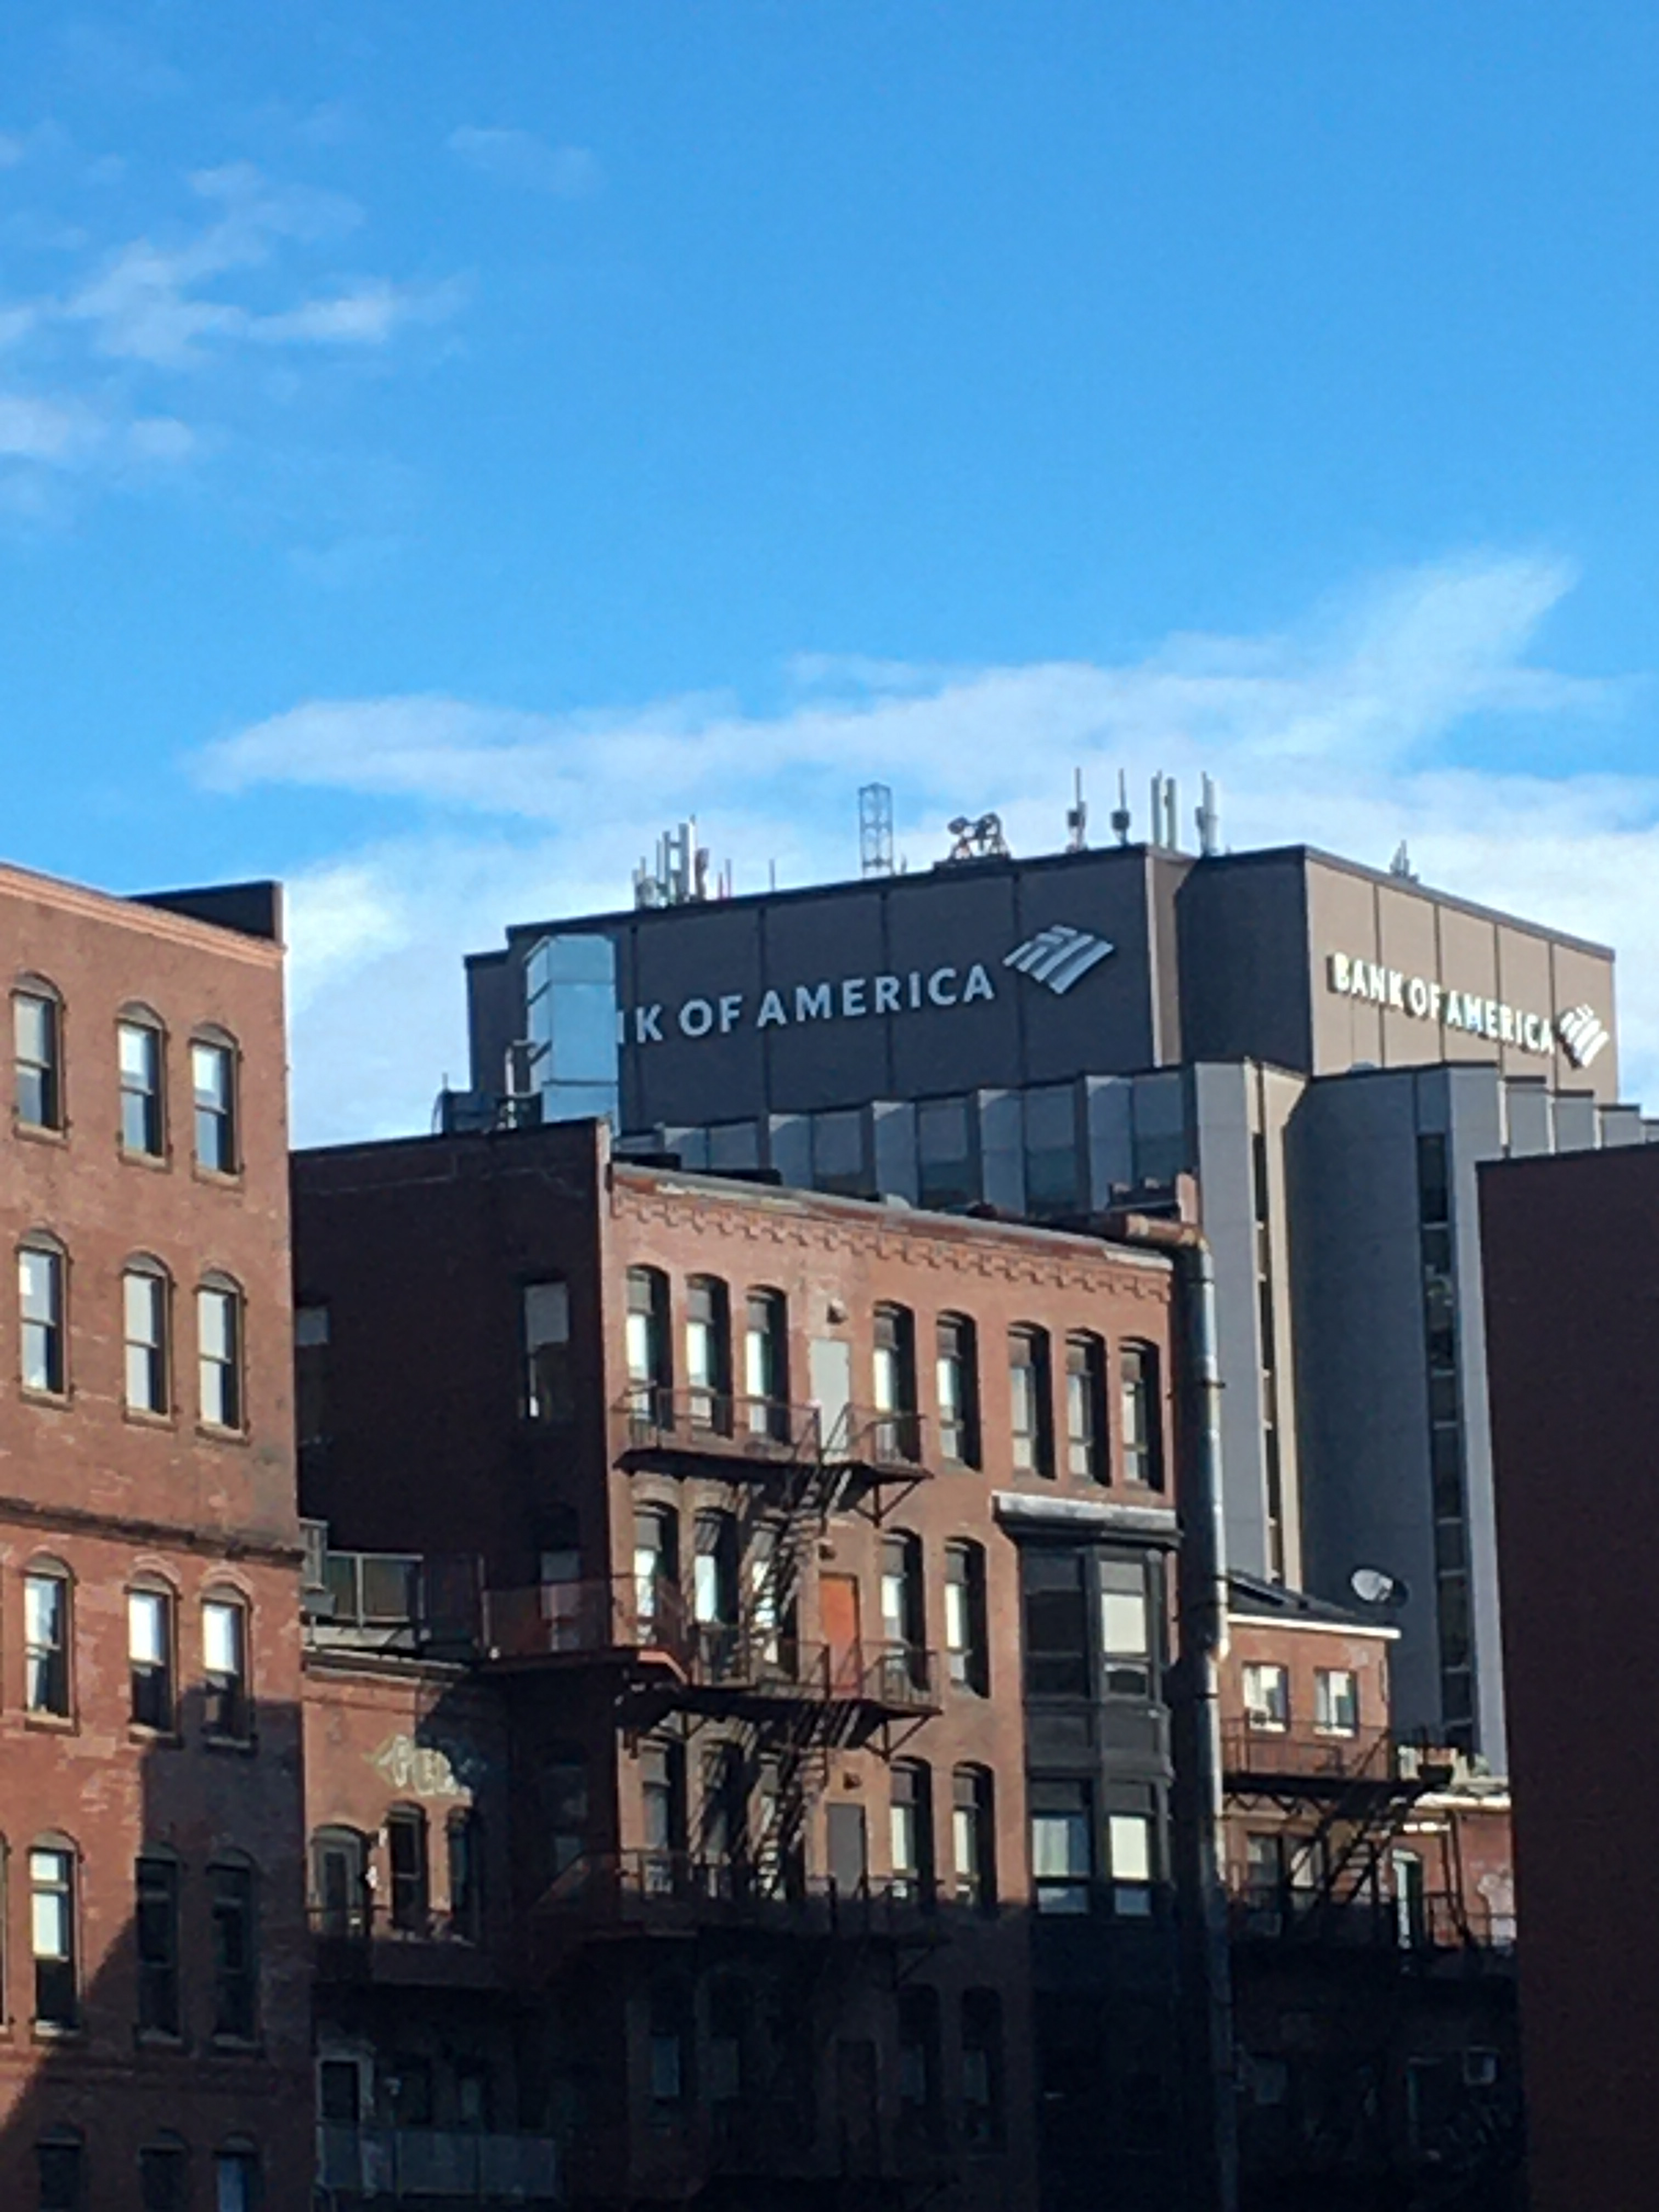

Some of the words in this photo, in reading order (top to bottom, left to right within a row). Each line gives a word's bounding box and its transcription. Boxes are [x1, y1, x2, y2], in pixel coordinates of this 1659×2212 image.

[678, 994, 742, 1037] OF
[757, 964, 995, 1029] AMERICA
[1329, 952, 1405, 1011] BANK
[1408, 976, 1442, 1020] OF
[1445, 989, 1556, 1054] AMERICA
